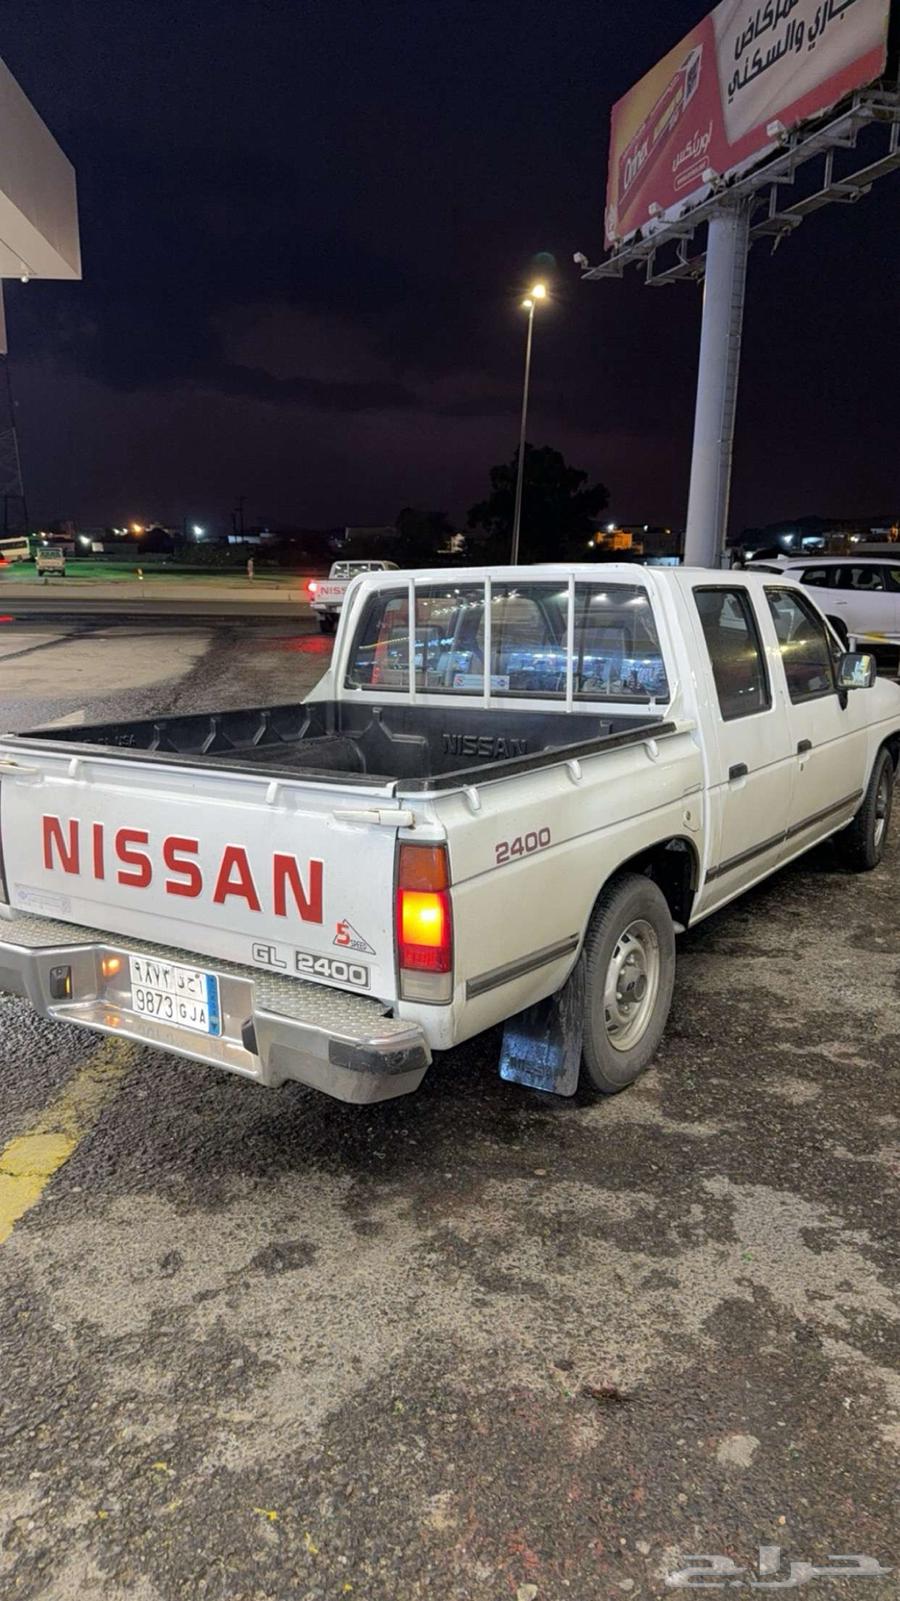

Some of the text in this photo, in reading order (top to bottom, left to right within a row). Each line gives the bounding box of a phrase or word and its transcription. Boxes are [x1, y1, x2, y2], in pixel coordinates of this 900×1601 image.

[442, 733, 528, 759] NISSAN
[495, 827, 551, 864] 2400
[42, 815, 324, 924] NISSAN
[336, 921, 352, 945] 5
[252, 942, 368, 987] GL 2400
[135, 989, 174, 1018] 9873
